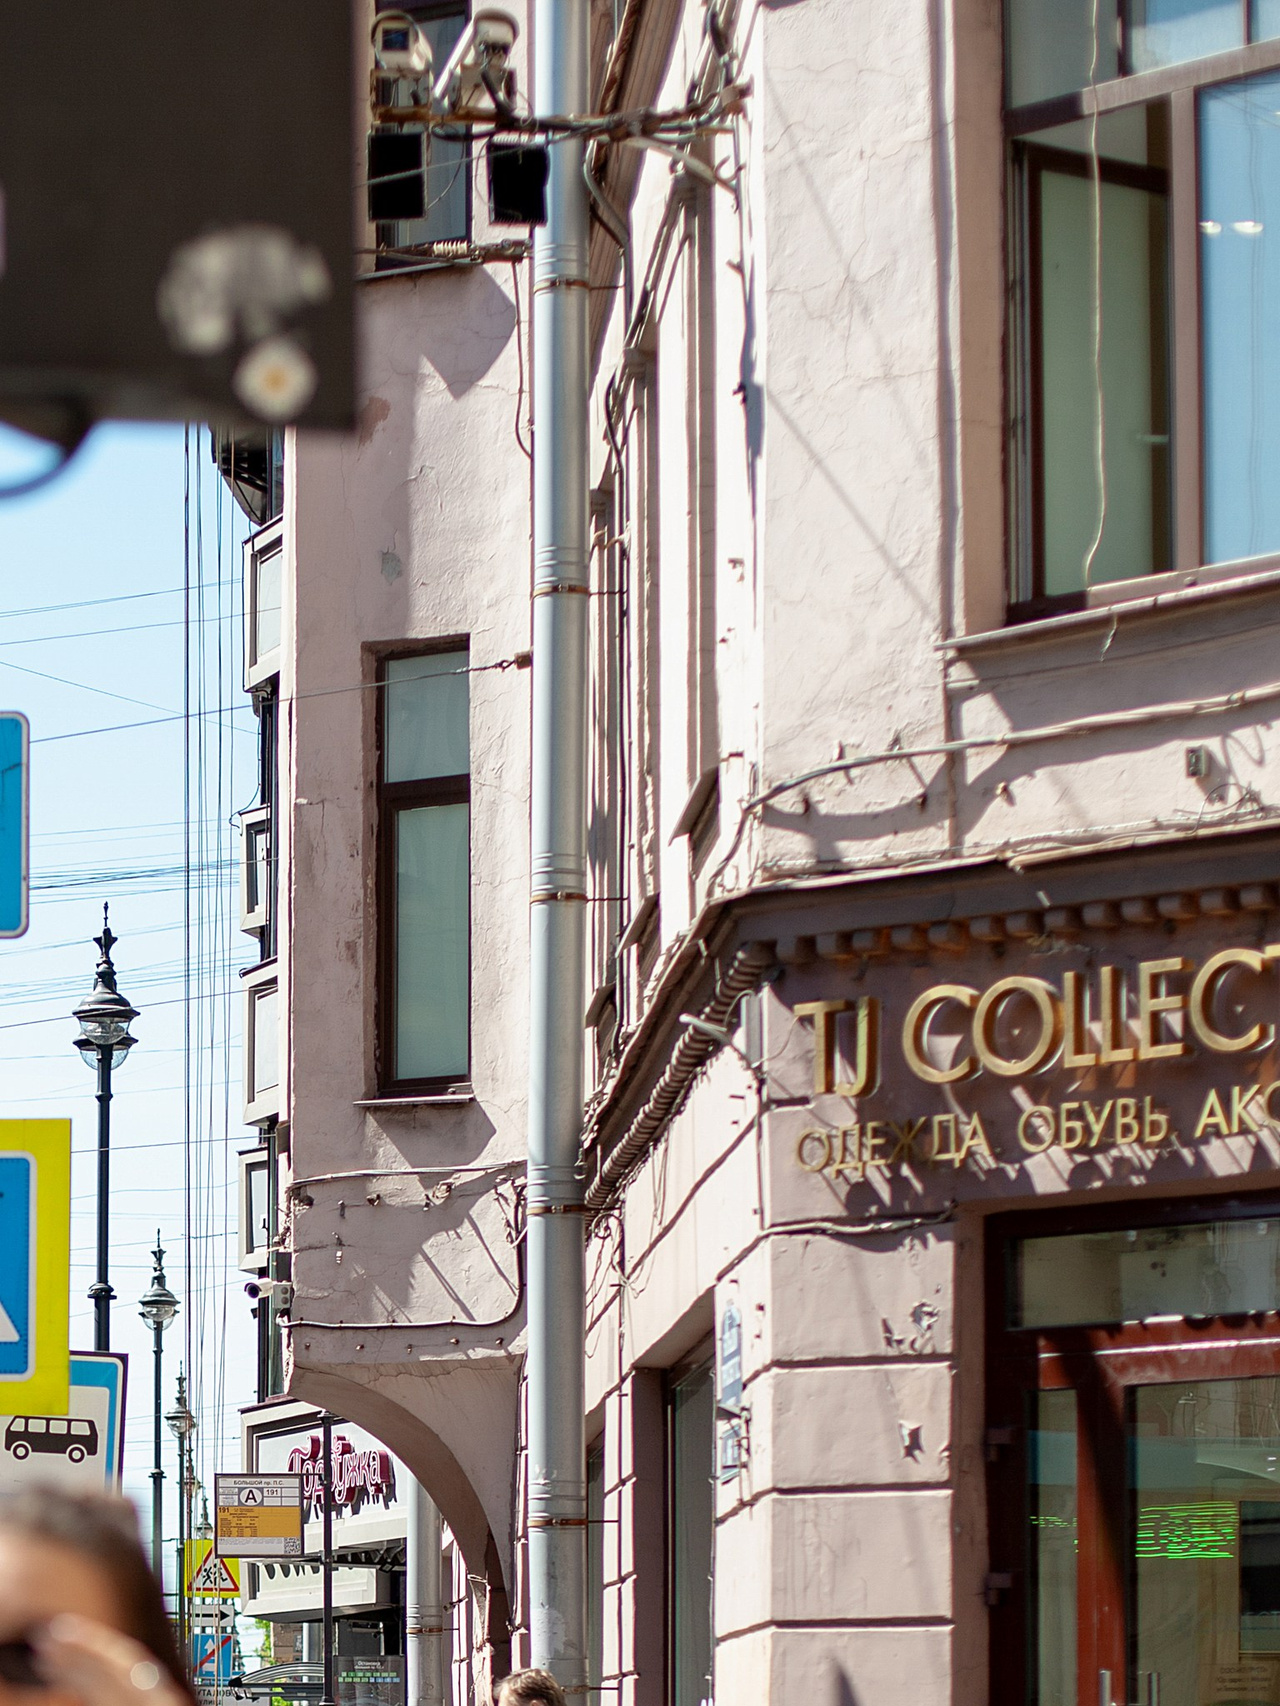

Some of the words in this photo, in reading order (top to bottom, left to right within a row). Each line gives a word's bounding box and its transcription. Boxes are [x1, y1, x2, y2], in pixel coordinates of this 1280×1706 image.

[794, 996, 878, 1097] TJ
[902, 944, 1280, 1084] COLLEC
[796, 1111, 992, 1179] ОДЕЖДА
[1019, 1095, 1169, 1154] ОБУВЬ
